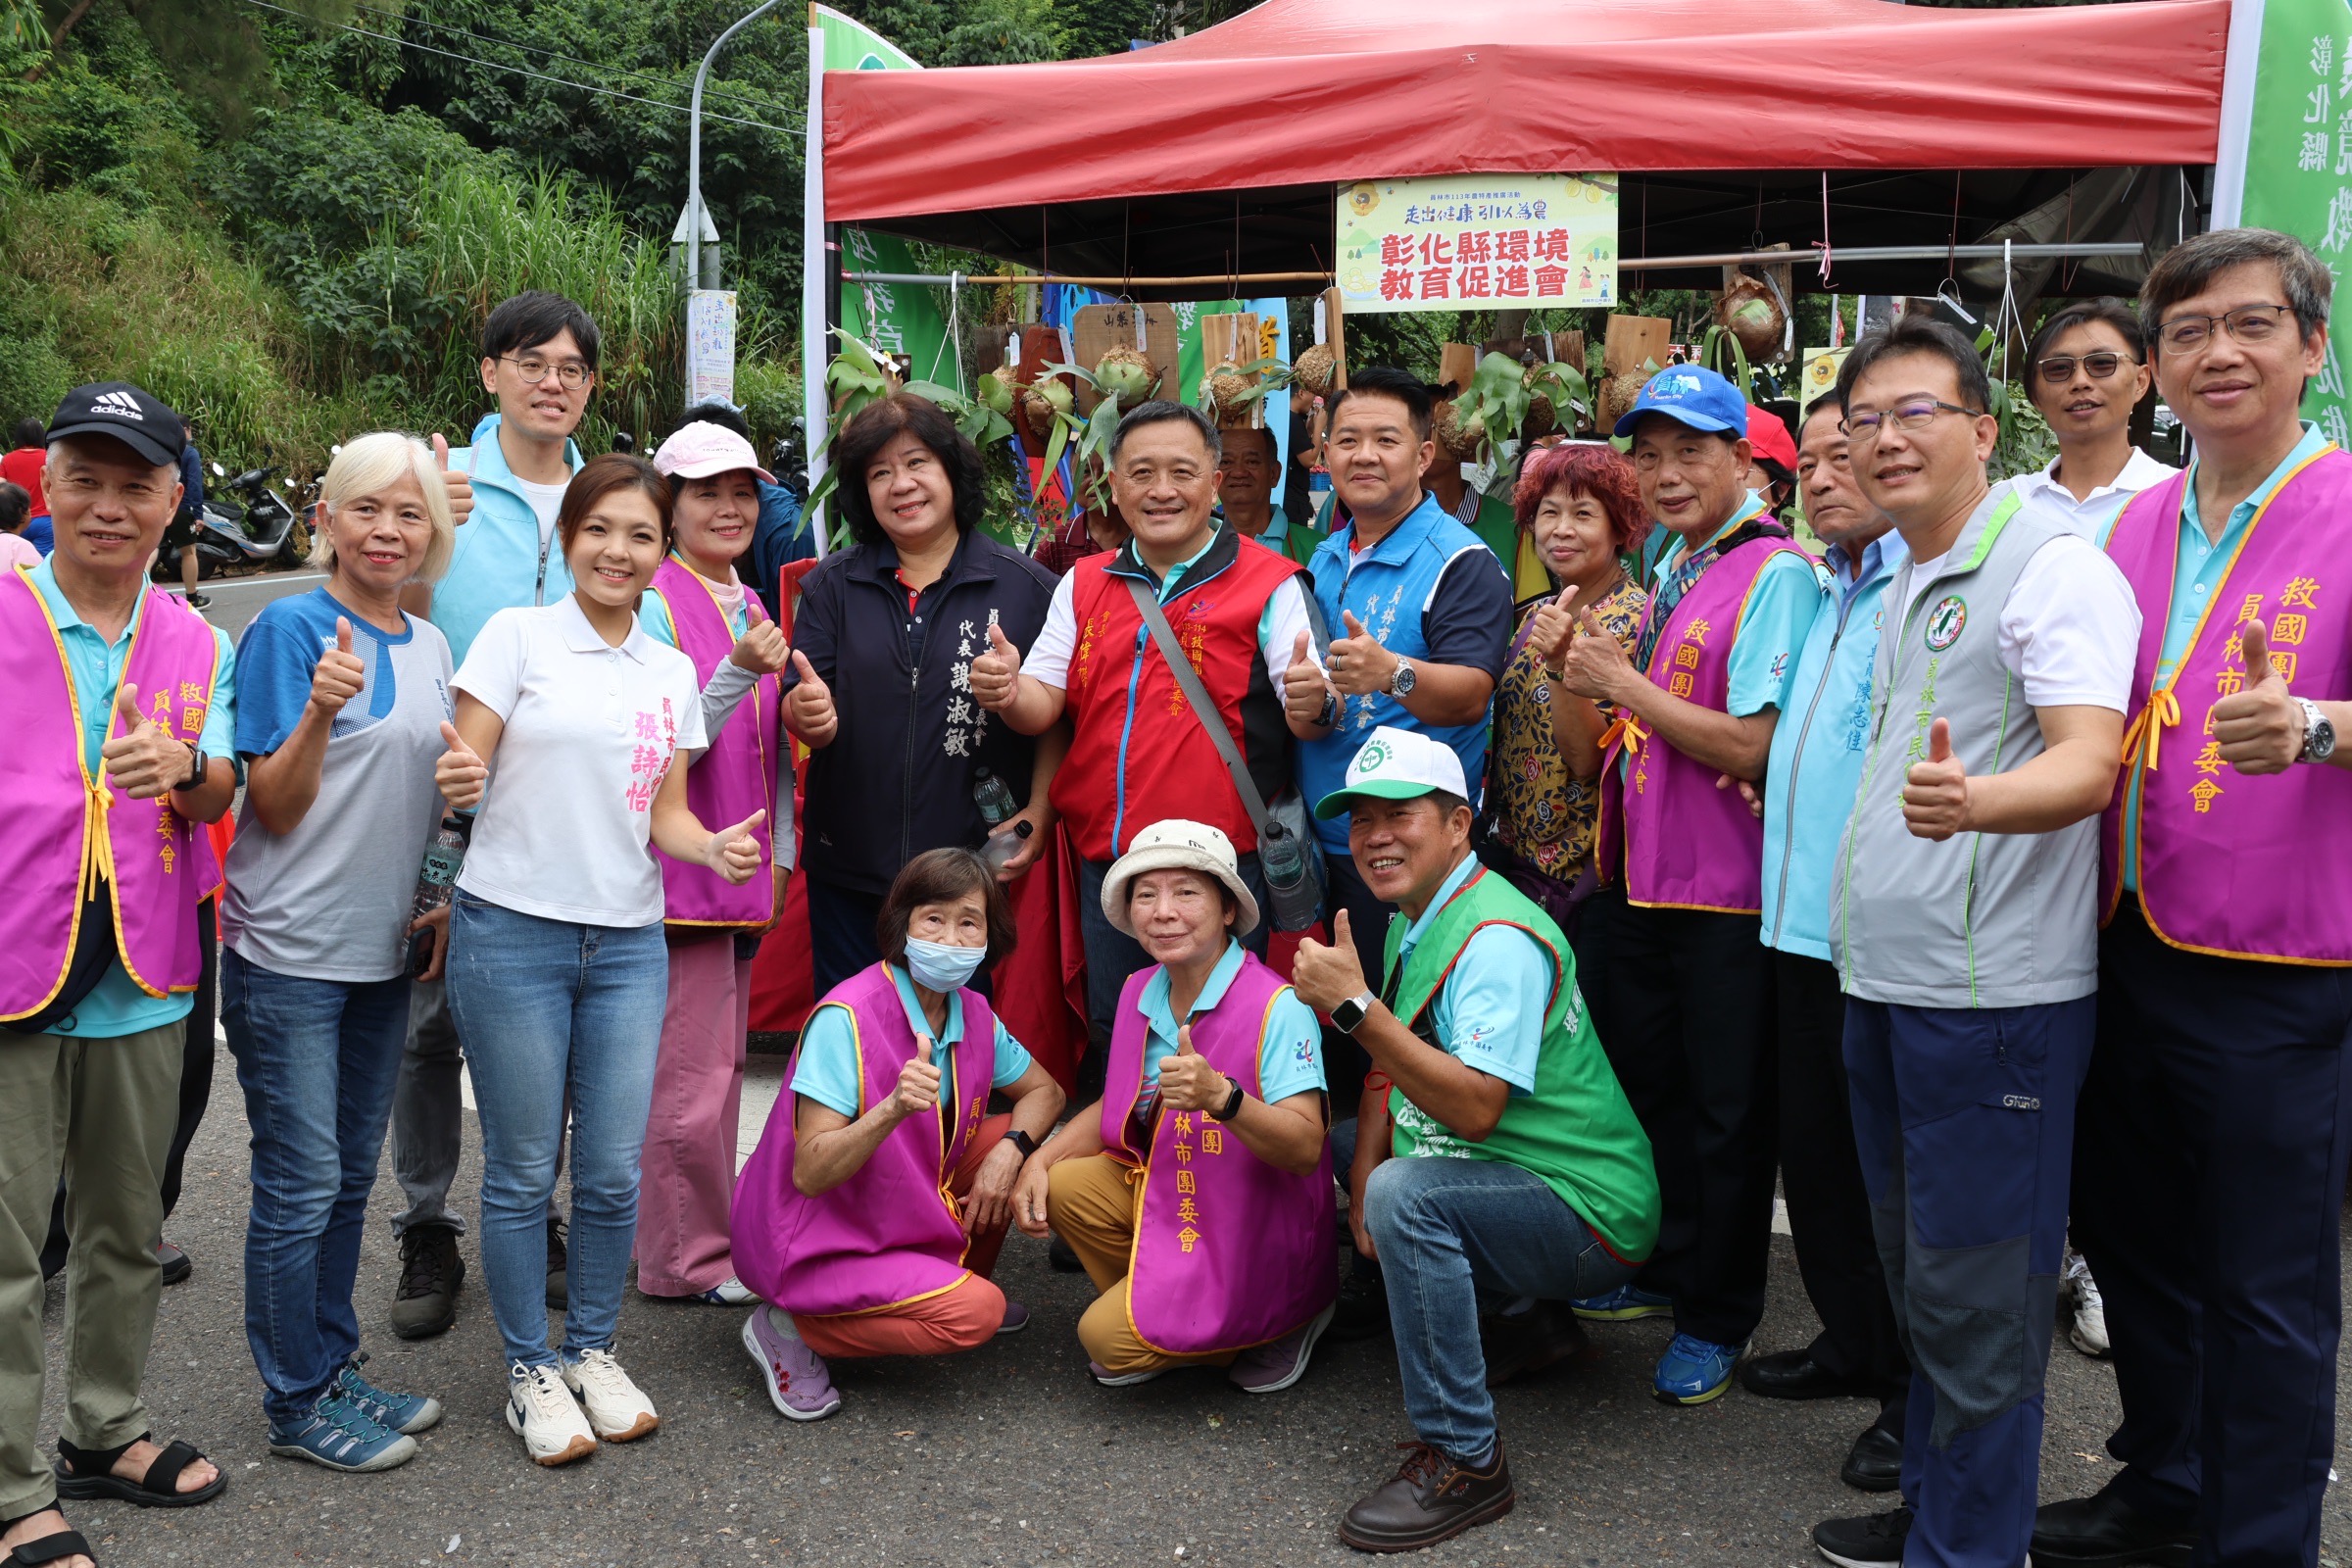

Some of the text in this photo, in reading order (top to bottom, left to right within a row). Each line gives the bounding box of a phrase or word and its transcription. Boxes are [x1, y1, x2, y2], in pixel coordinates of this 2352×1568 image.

[1404, 199, 1547, 224] 走出健康 引以為農
[1381, 228, 1569, 267] 彰化縣環境
[1380, 264, 1569, 302] 教育促進會
[90, 405, 144, 421] adidas
[2268, 576, 2321, 685] 救國團
[1669, 617, 1711, 699] 救國團
[625, 711, 662, 812] 張詩怡
